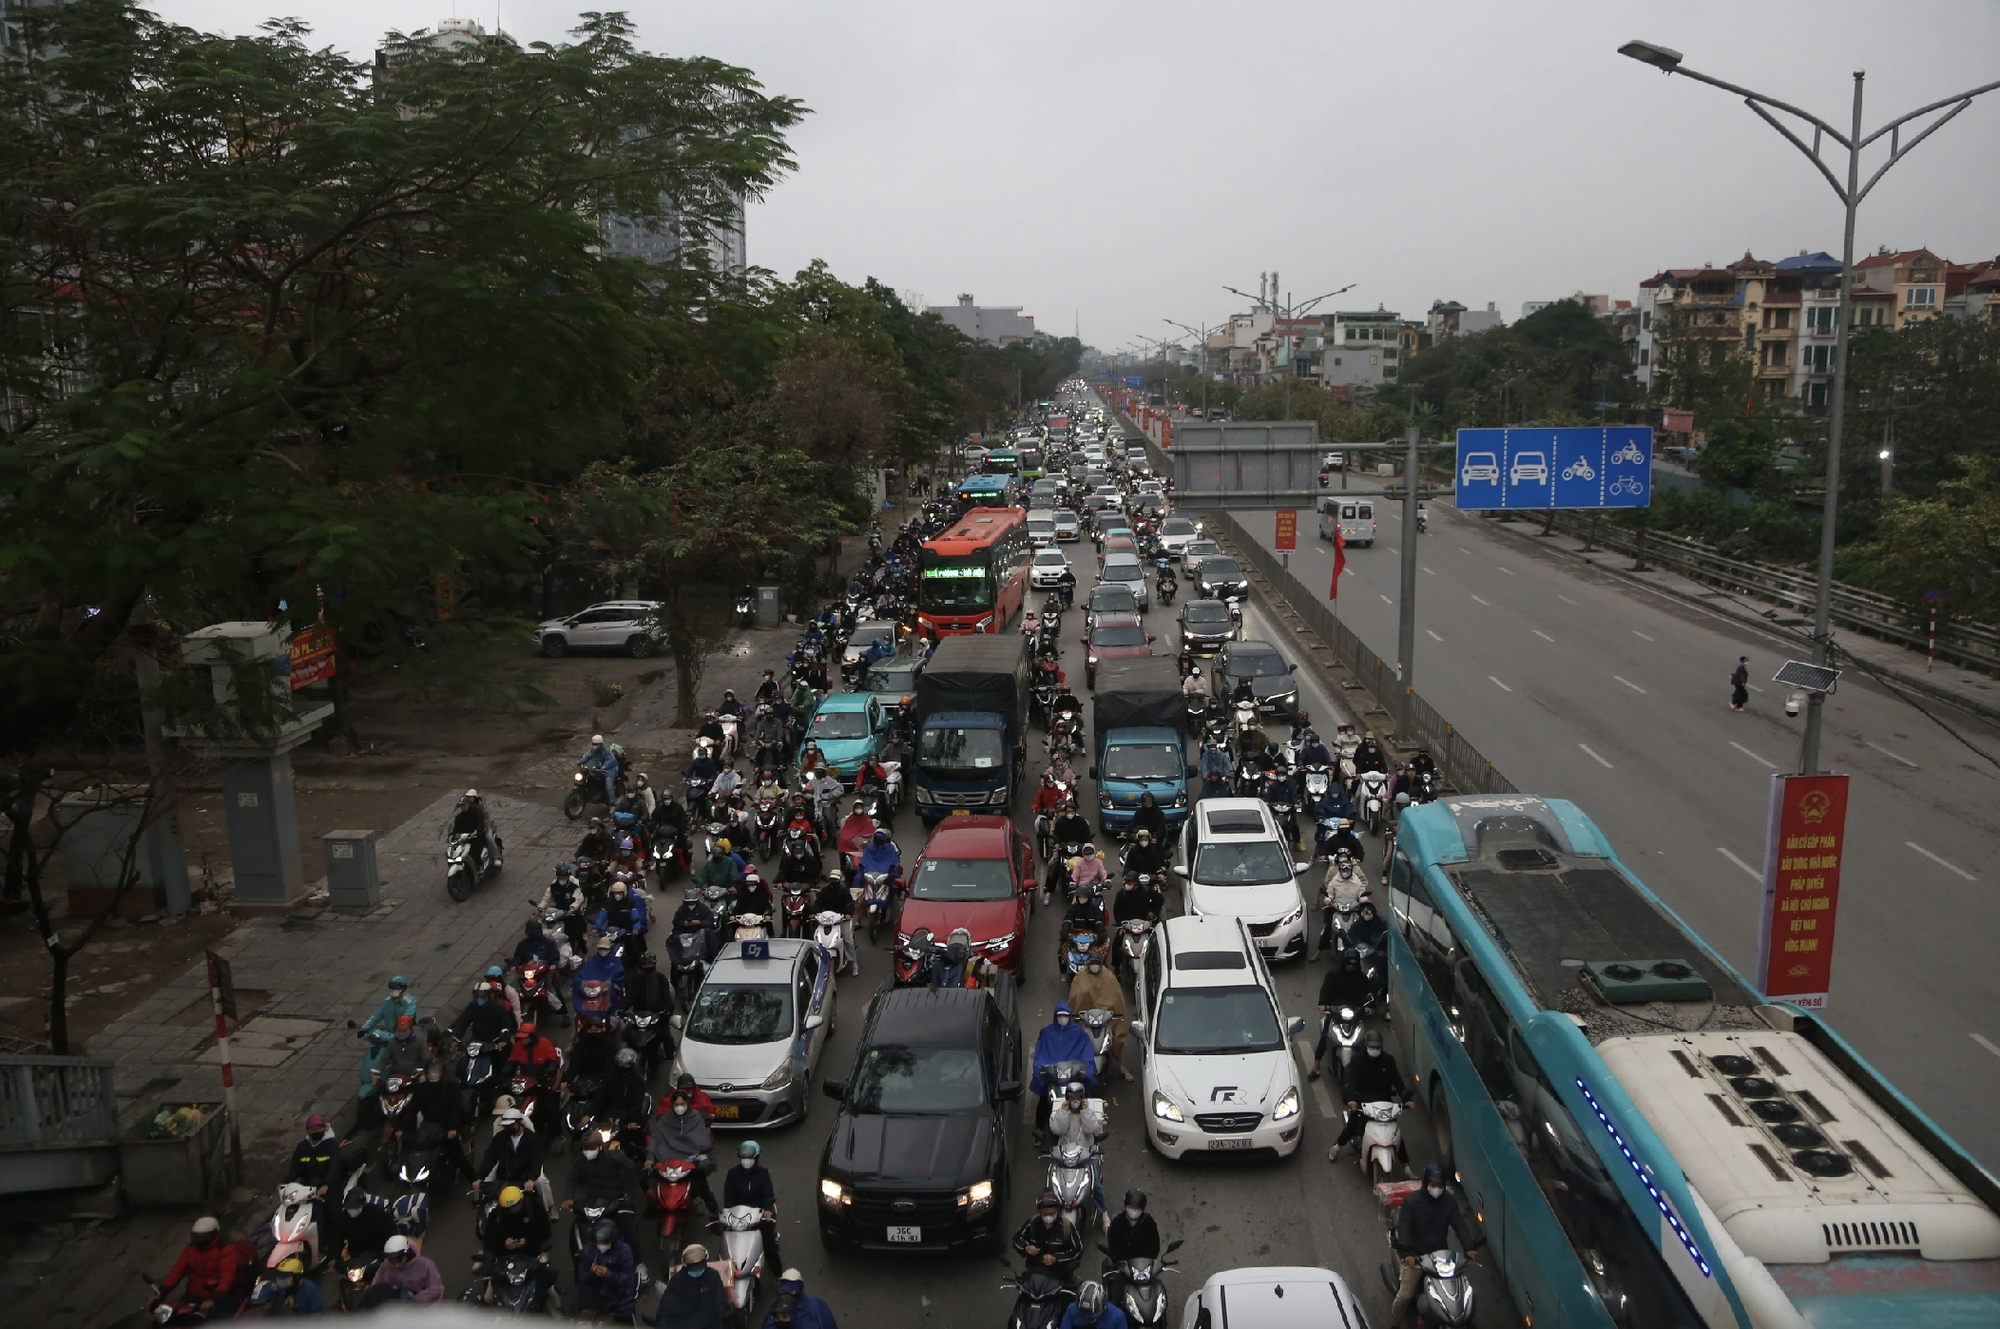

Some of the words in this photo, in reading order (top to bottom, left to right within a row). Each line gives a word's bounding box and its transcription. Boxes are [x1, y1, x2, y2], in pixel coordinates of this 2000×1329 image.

[1791, 917, 1802, 934] VIỆT
[1803, 919, 1817, 930] NAM
[1798, 997, 1811, 1006] YÊN
